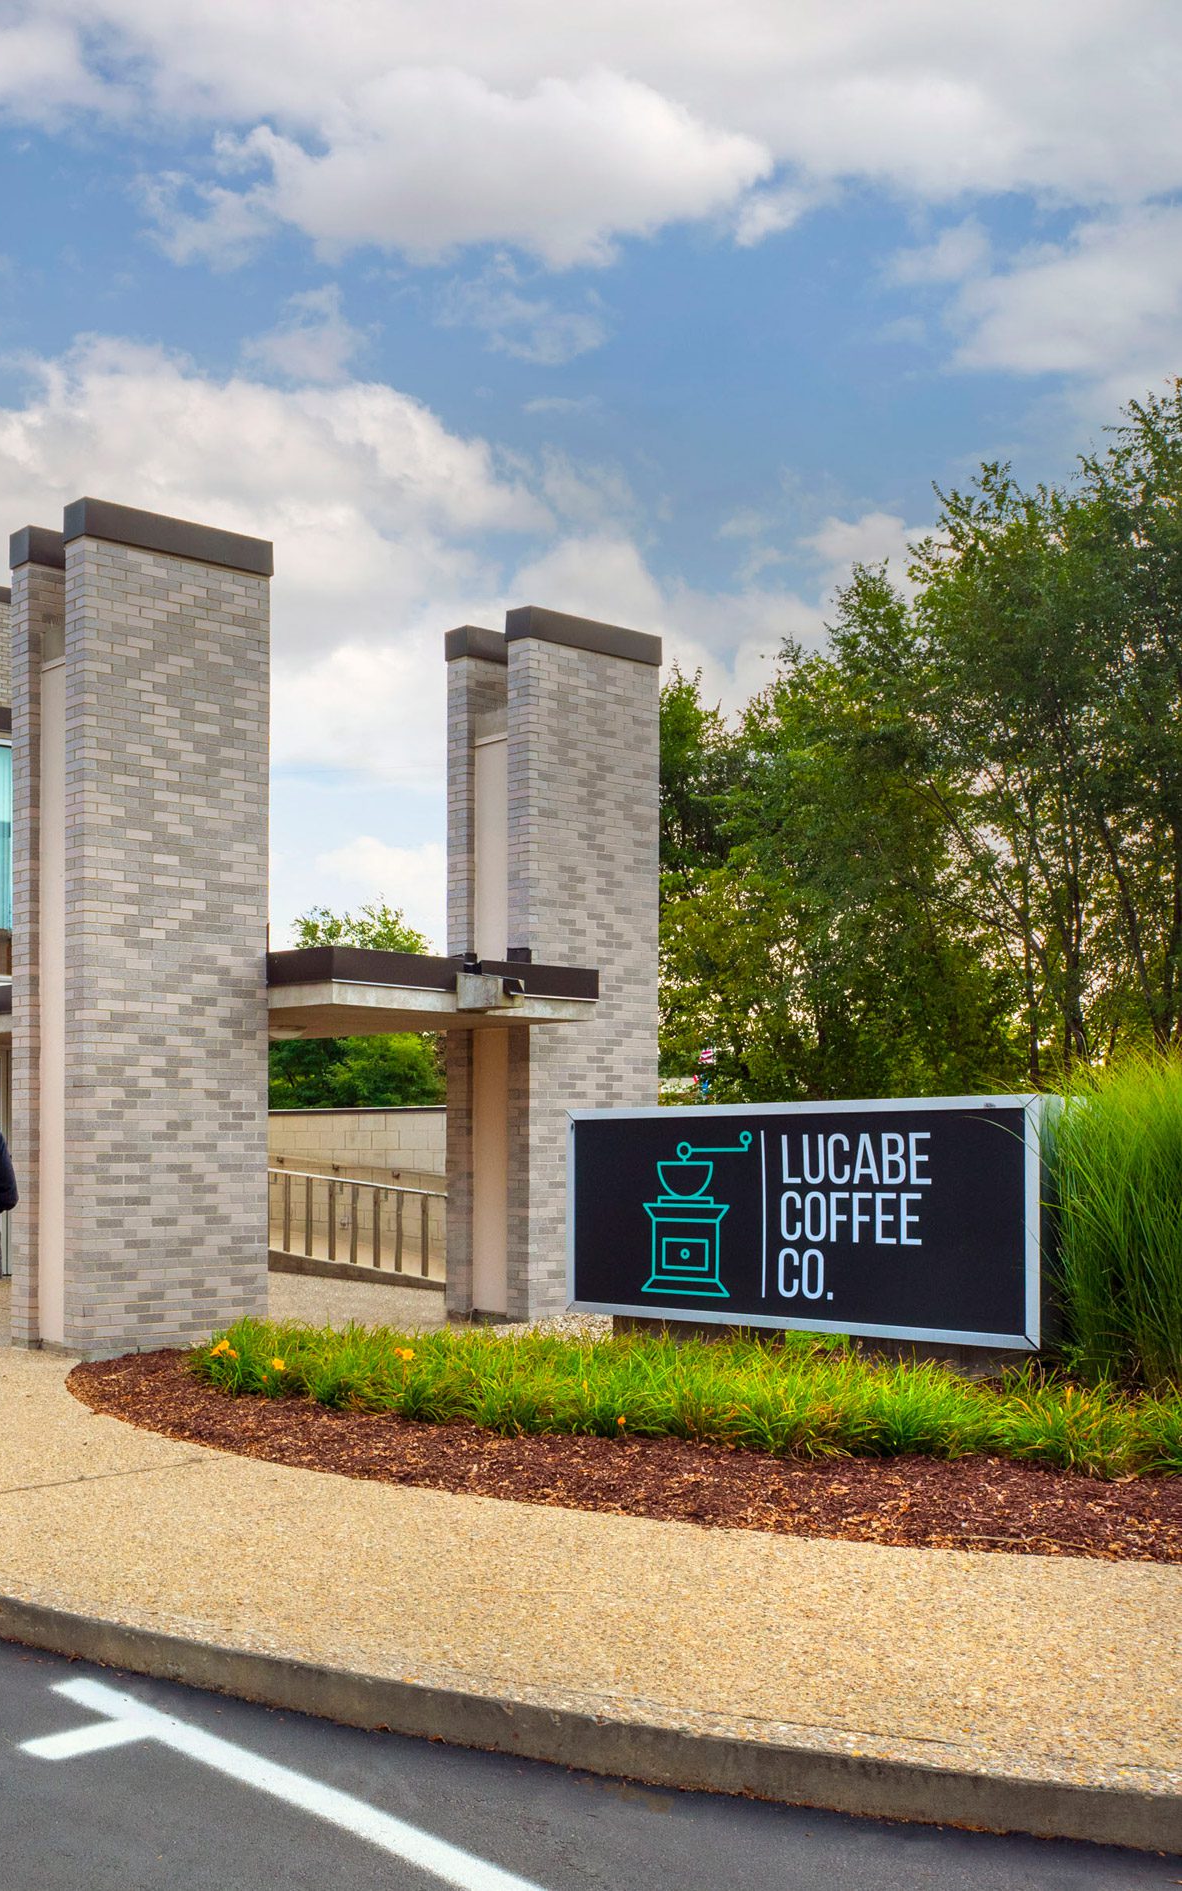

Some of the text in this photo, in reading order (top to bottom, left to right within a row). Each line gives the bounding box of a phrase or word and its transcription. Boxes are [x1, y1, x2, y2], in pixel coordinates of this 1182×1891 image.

[781, 1132, 932, 1185] LUCABE
[780, 1191, 923, 1246] COFFEE
[778, 1247, 834, 1301] CO.
